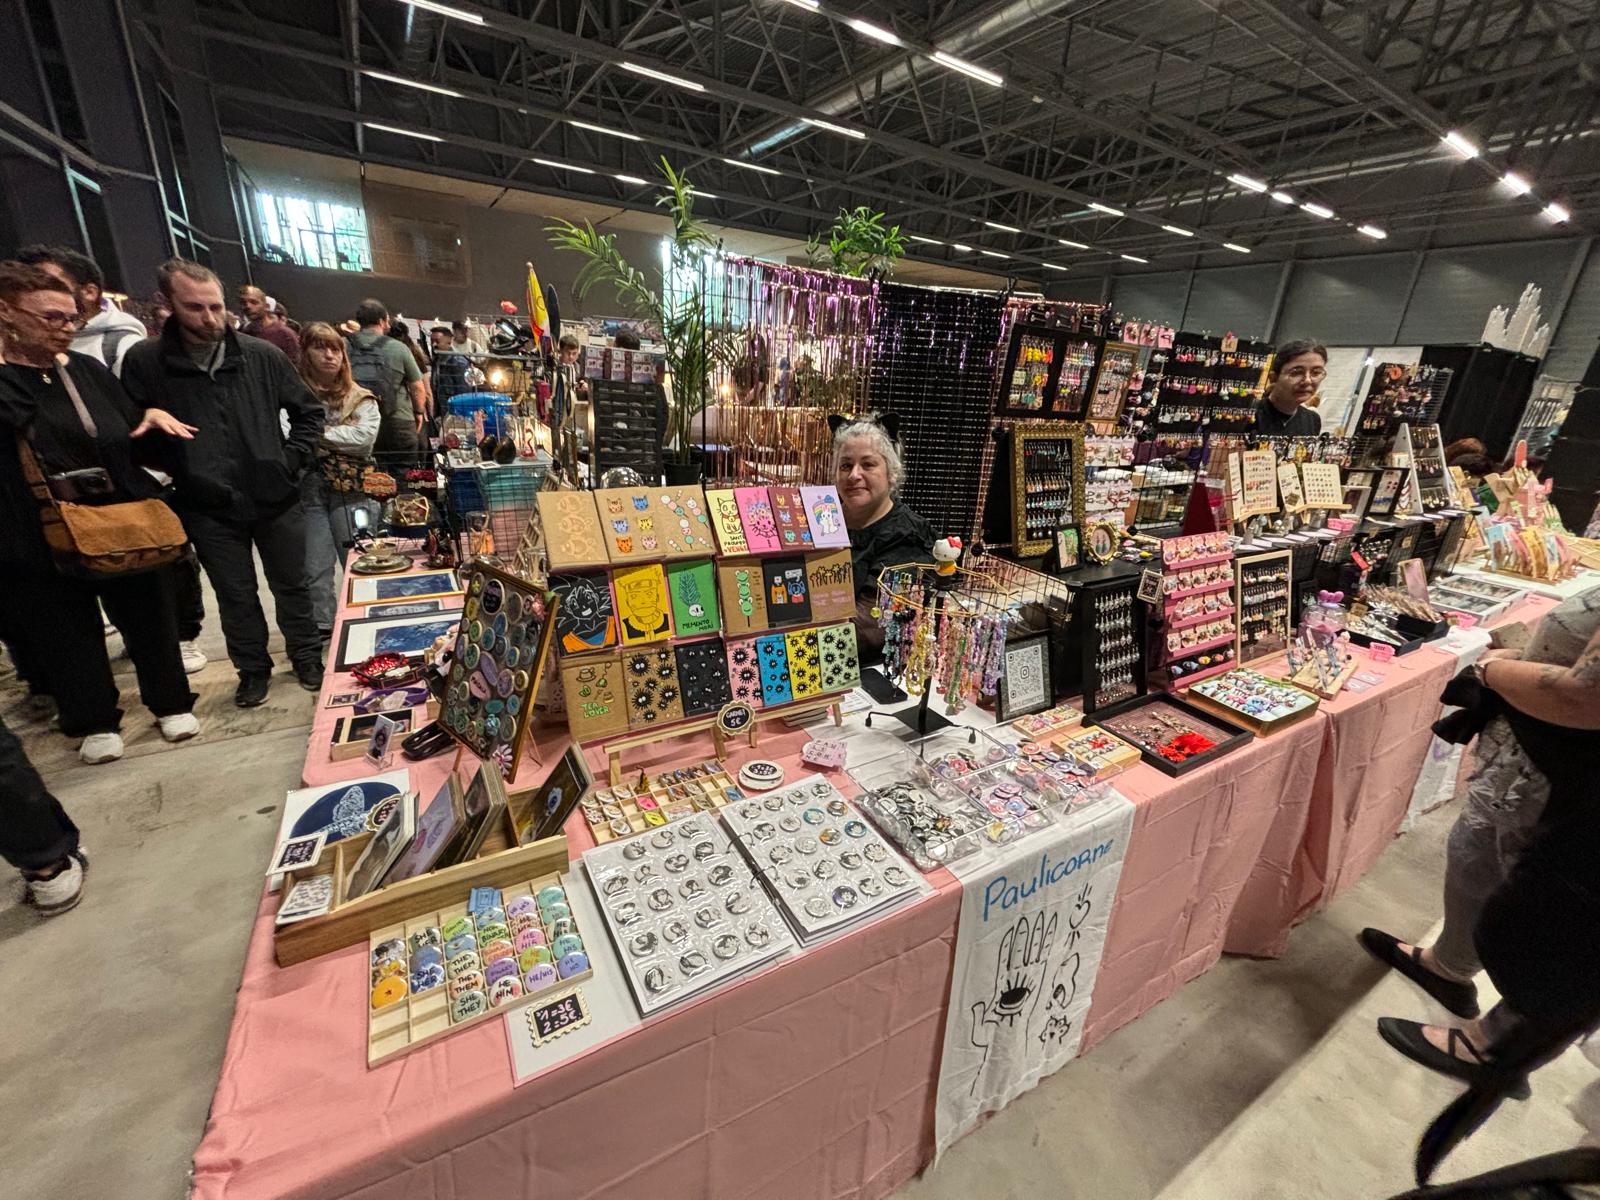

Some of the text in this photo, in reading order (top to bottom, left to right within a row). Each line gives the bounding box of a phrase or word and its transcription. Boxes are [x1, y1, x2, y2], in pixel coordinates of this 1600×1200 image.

[683, 619, 709, 629] MEMENTO
[581, 702, 598, 711] TEA
[584, 706, 609, 718] LOVER
[731, 718, 741, 726] 5€
[414, 929, 432, 943] SHE
[523, 932, 535, 940] HE
[416, 967, 436, 980] SHE
[454, 960, 476, 975] THEM
[416, 974, 438, 989] HER
[458, 973, 478, 984] THEY
[499, 980, 511, 988] HE
[454, 980, 479, 994] THEM
[460, 993, 478, 1006] SHE
[457, 1000, 481, 1016] THEY
